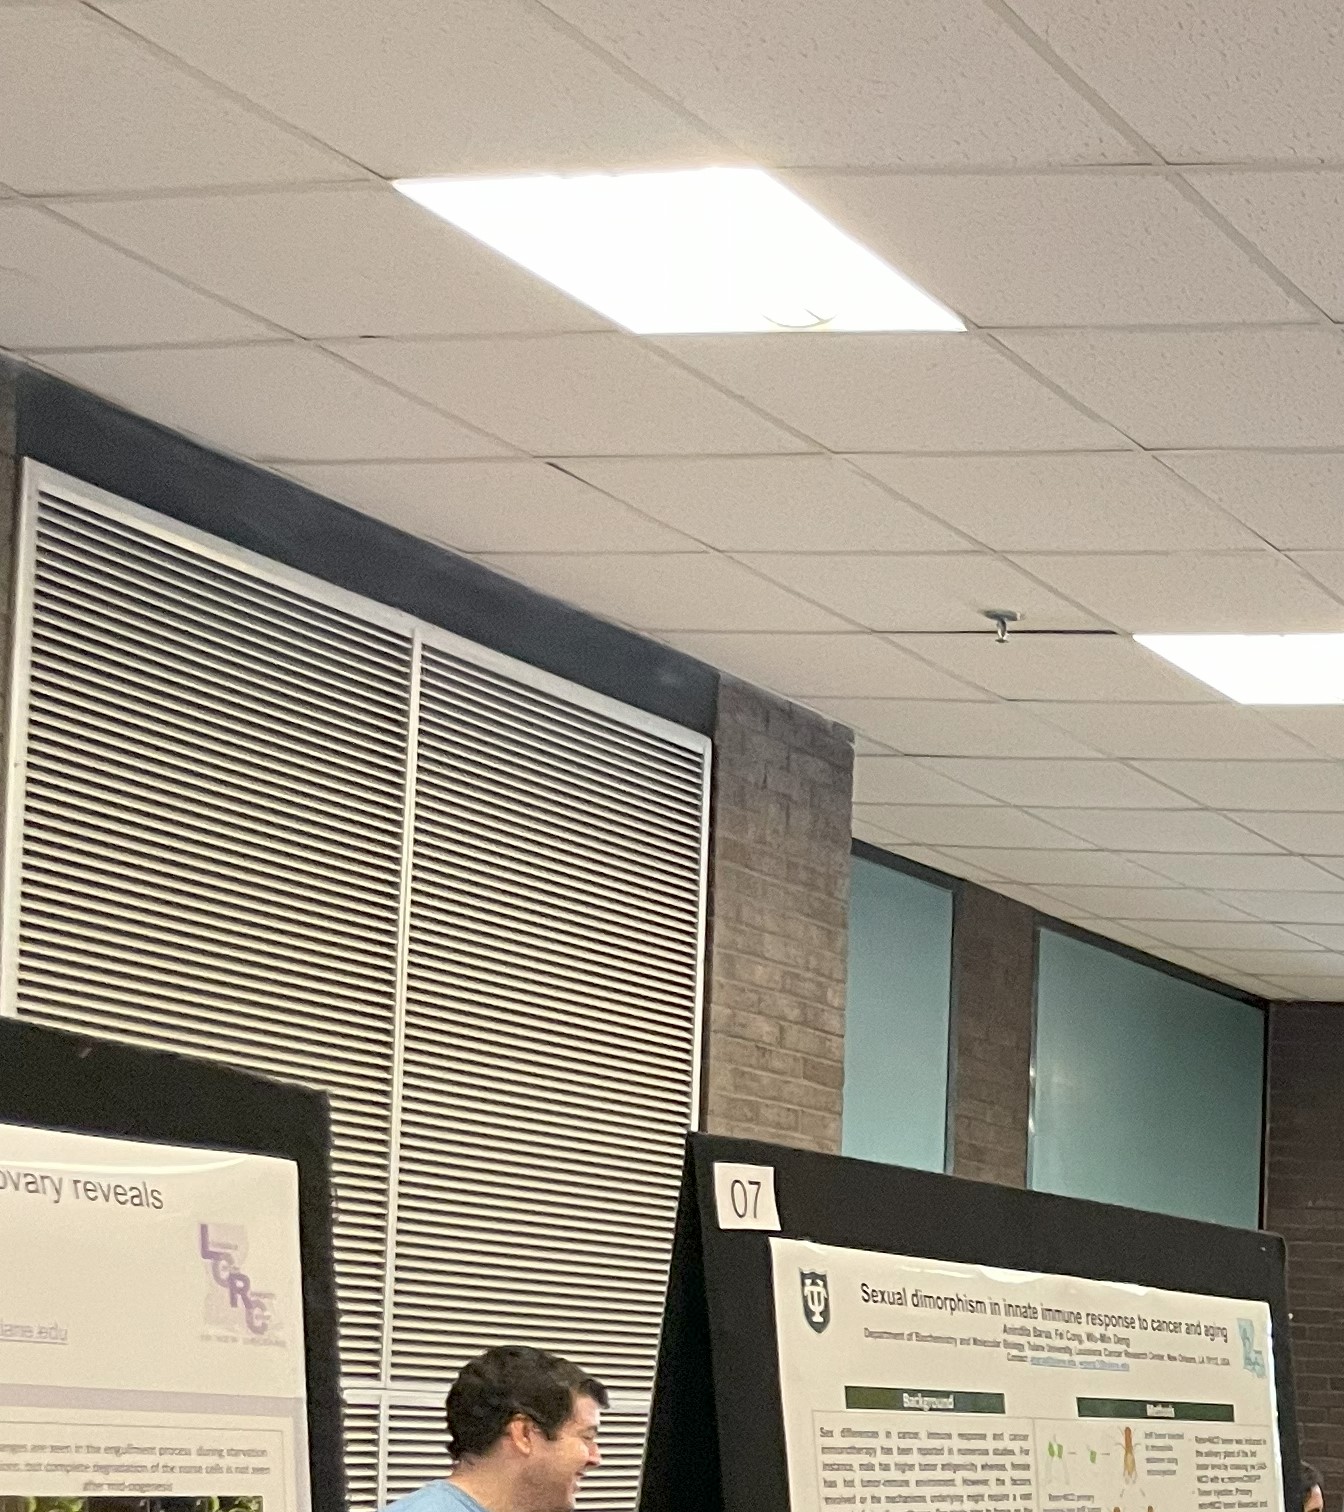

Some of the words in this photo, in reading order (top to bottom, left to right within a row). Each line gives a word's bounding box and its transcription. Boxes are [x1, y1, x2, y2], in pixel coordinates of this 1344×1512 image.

[73, 1179, 164, 1210] reveals
[730, 1180, 761, 1219] 07
[860, 1283, 907, 1307] Sexual
[911, 1289, 987, 1316] dimorphism
[990, 1296, 1001, 1315] in
[1003, 1298, 1038, 1320] innate
[1041, 1303, 1082, 1325] immune
[1086, 1311, 1135, 1331] response
[1138, 1313, 1148, 1331] to
[1151, 1316, 1182, 1335] cancer
[1185, 1318, 1202, 1337] and
[1204, 1322, 1228, 1343] aging
